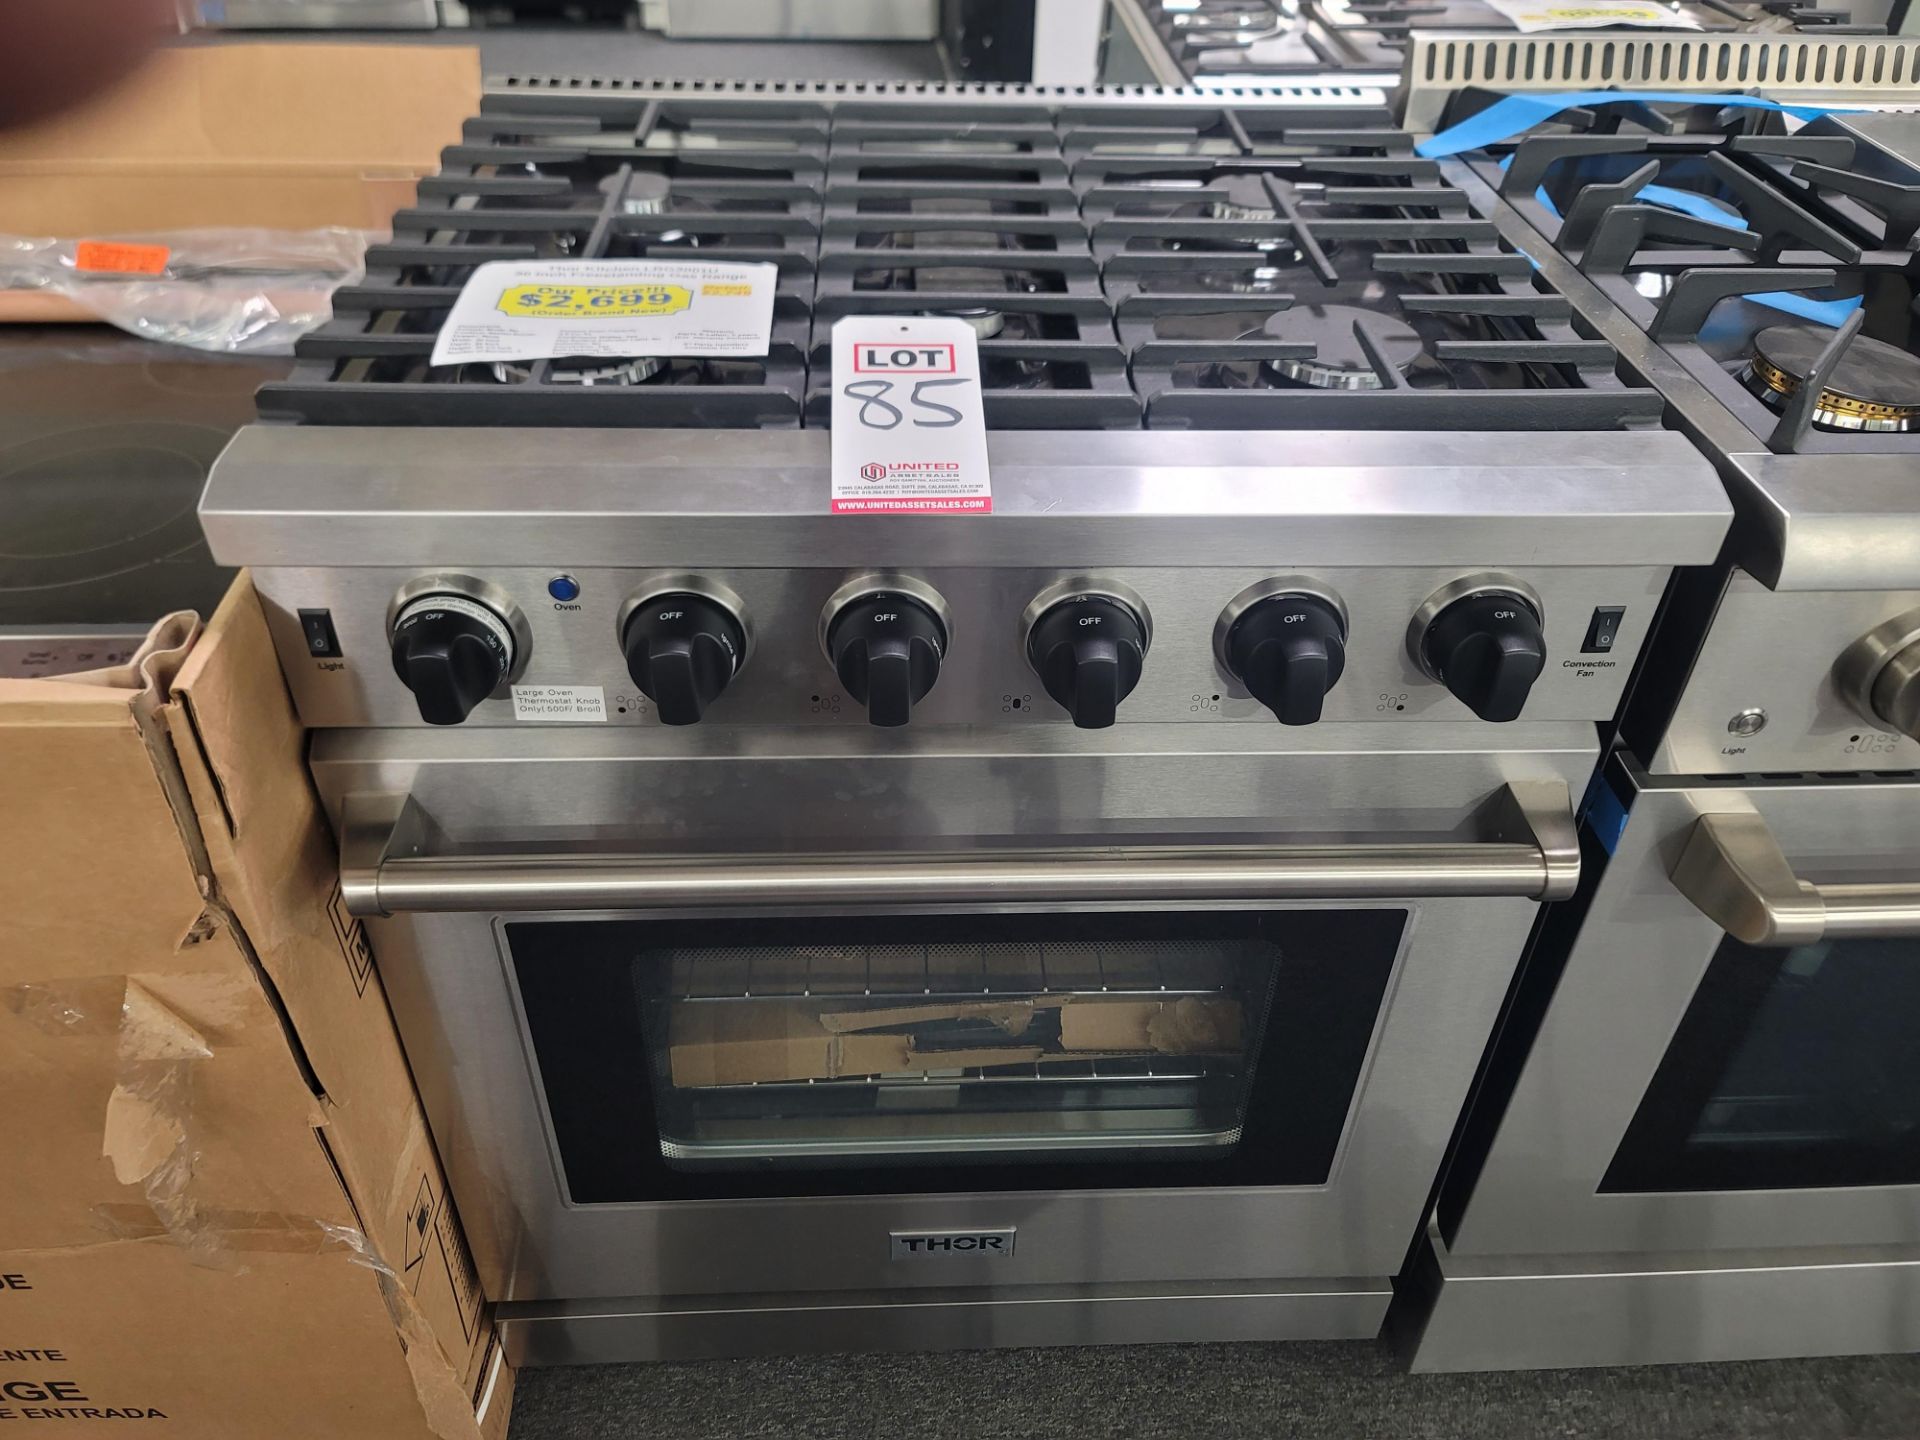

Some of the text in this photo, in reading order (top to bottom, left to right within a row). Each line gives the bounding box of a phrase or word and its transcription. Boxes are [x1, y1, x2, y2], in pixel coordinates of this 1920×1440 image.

[701, 273, 749, 281] Range
[537, 286, 576, 296] Our
[517, 292, 673, 311] $2,699
[582, 309, 626, 317] Brand
[867, 349, 943, 368] LOT
[843, 378, 973, 431] 85
[888, 462, 960, 471] UNITED
[838, 500, 986, 511] WWW.UNITEDASSETSALES.COM
[554, 603, 582, 611] Oven
[660, 612, 683, 620] OFF
[874, 613, 898, 622] OFF
[1284, 614, 1307, 624] OFF
[1494, 611, 1517, 620] OFF
[1079, 617, 1102, 626] OFF
[318, 662, 344, 672] Light
[1562, 660, 1616, 668] Convection
[516, 688, 573, 697] Large Oven
[518, 697, 601, 705] Thermostat Knob
[1720, 747, 1746, 756] Light
[900, 1236, 1004, 1252] THOR
[0, 1381, 89, 1401] GE
[21, 1408, 169, 1419] ENTRADA
